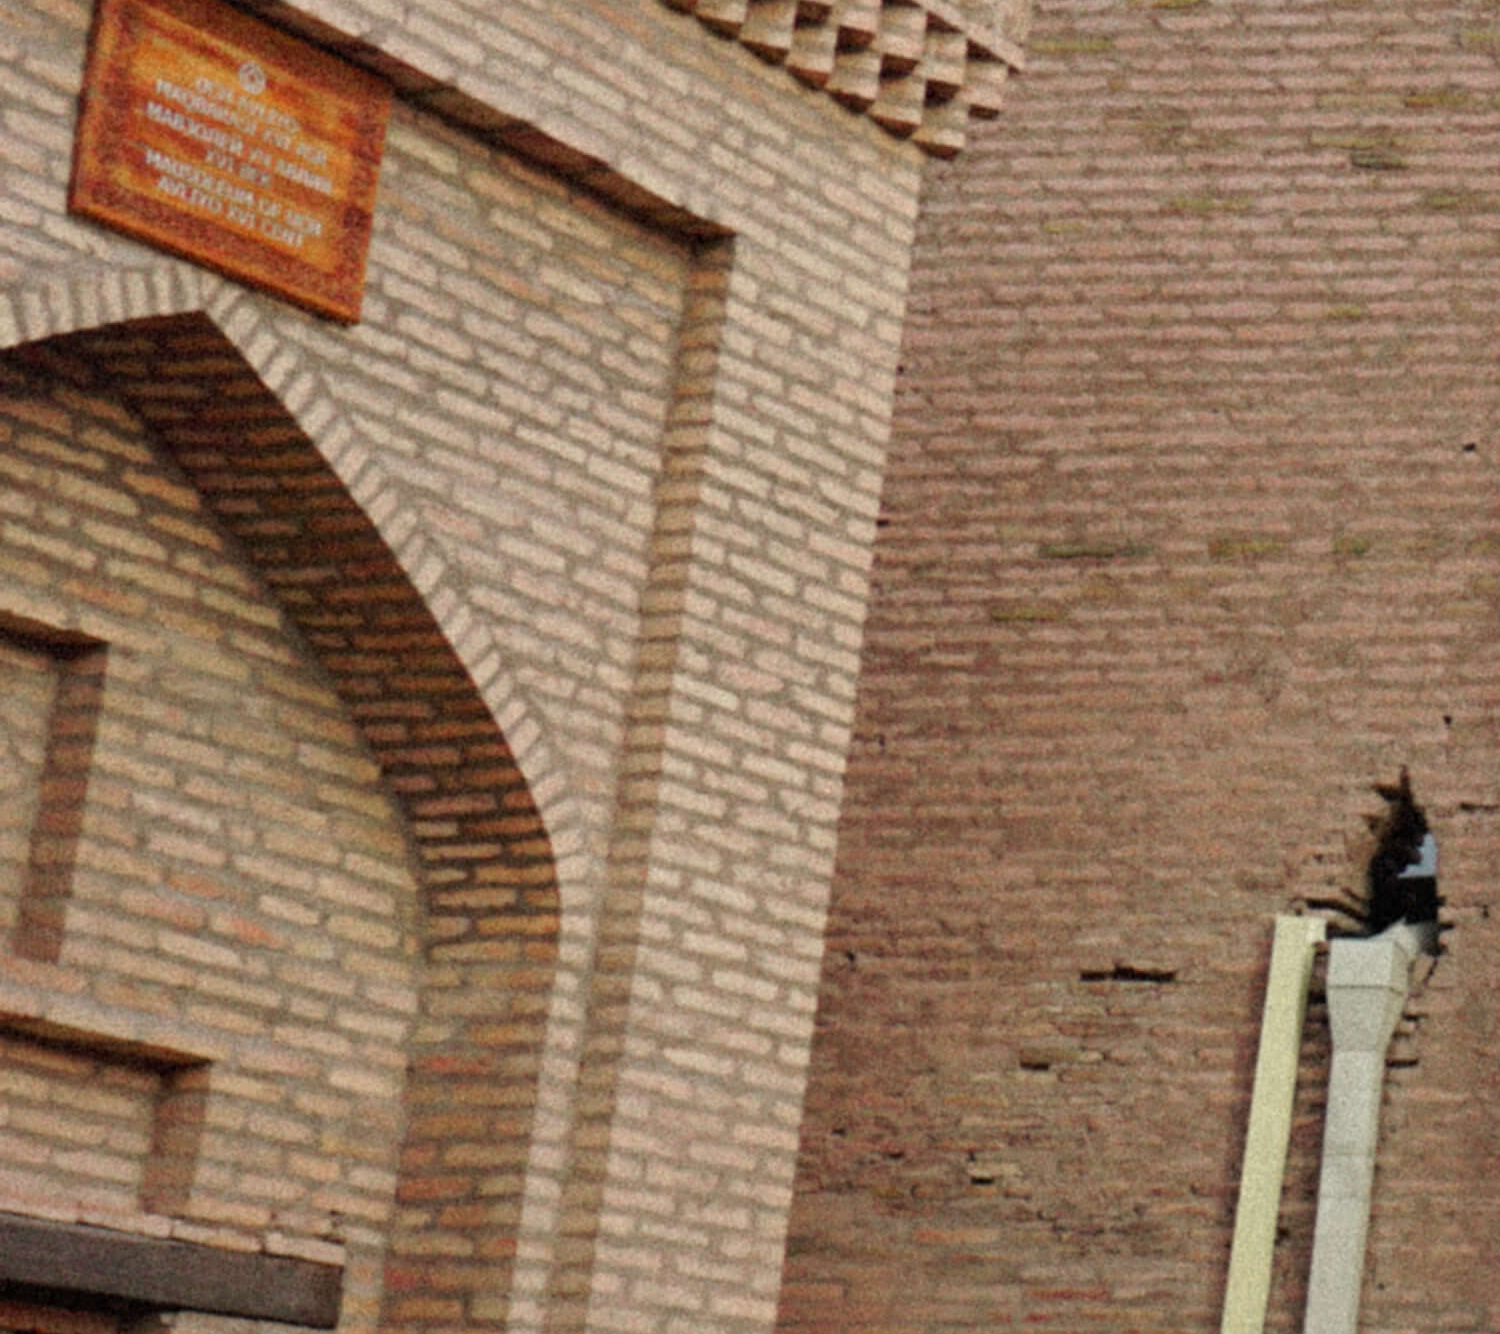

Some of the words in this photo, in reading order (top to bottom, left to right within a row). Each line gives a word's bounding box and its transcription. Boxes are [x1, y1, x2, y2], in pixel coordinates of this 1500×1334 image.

[146, 101, 243, 156] МАВЗОЛЕЙ
[145, 147, 254, 205] MAUSOLEUM
[258, 197, 281, 218] OF
[157, 175, 222, 214] AVLIYO
[227, 201, 256, 229] XVI
[261, 218, 303, 247] CENT
